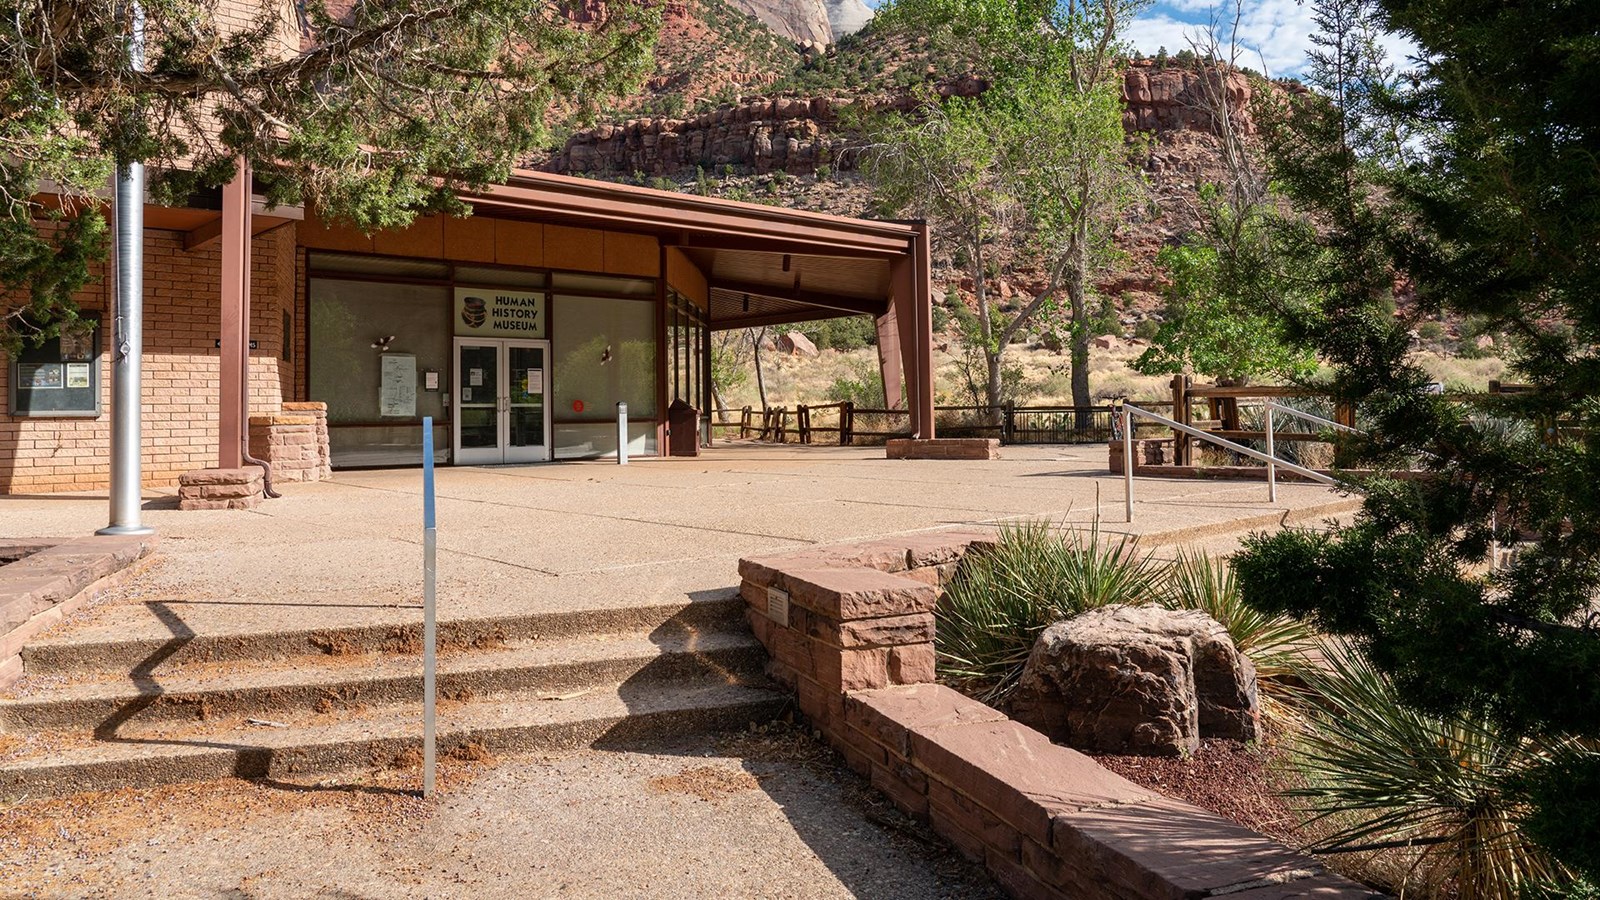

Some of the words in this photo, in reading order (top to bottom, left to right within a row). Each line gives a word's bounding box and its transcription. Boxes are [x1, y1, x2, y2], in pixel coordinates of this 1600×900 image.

[495, 296, 535, 307] HUMAN
[492, 308, 538, 319] HISTORY
[493, 321, 537, 331] MUSEUM
